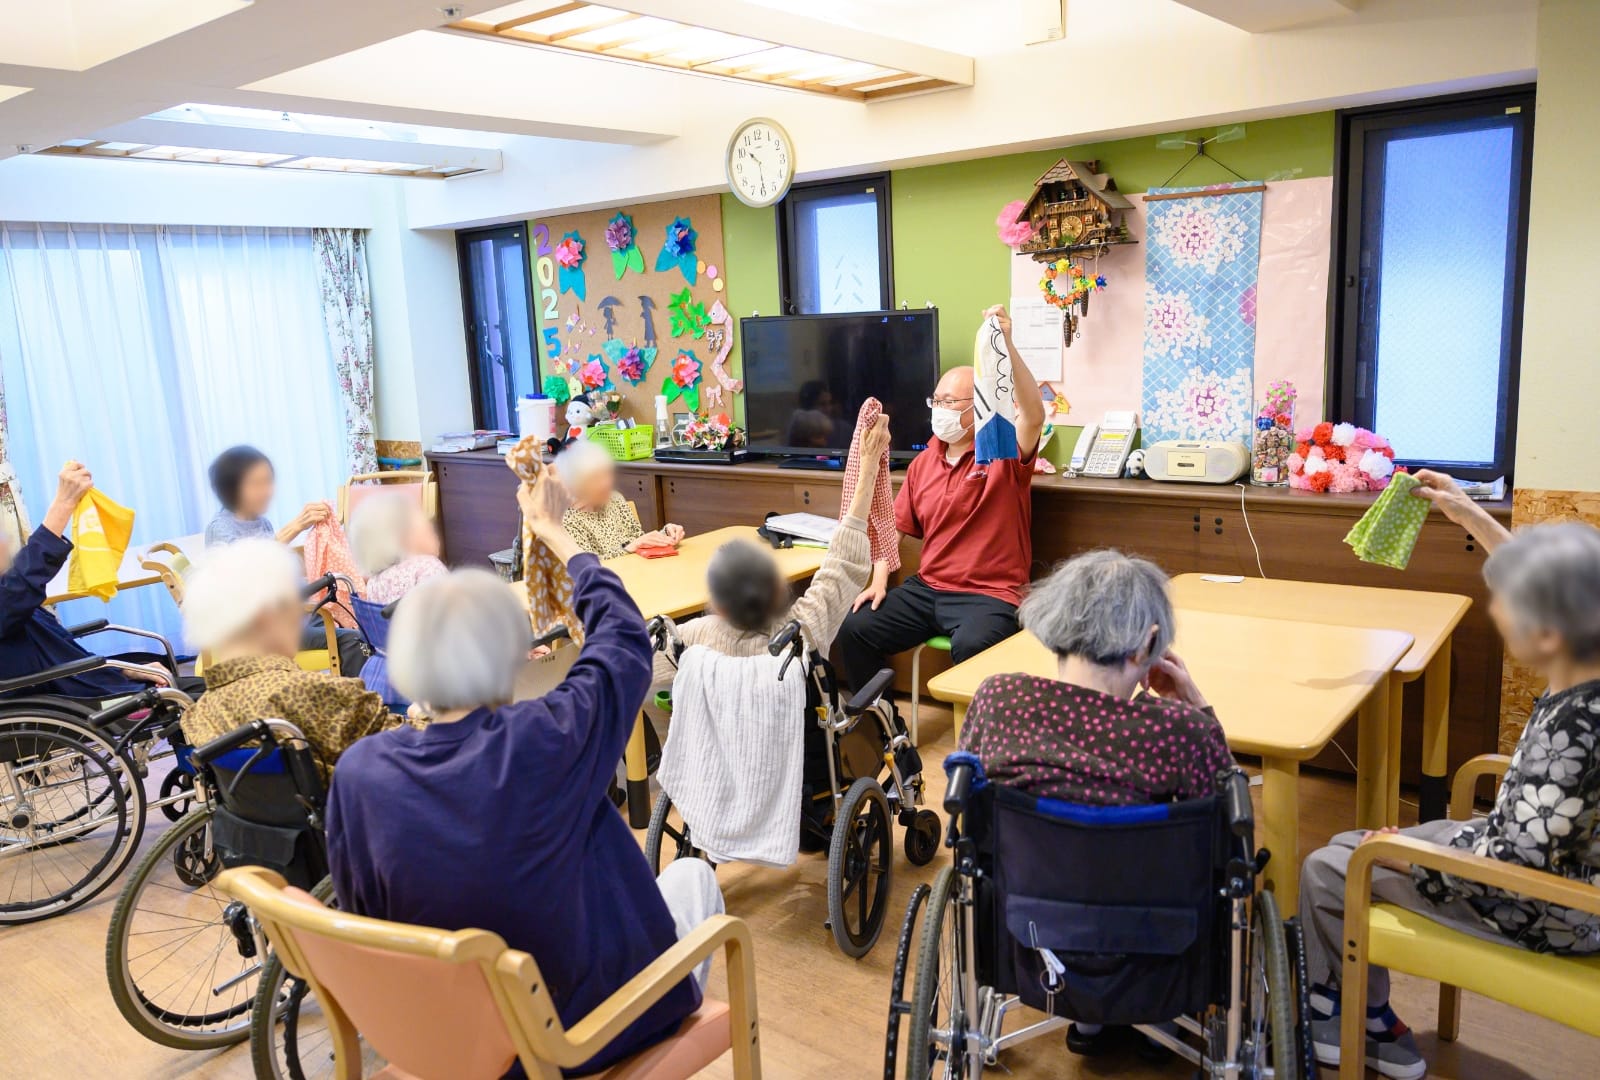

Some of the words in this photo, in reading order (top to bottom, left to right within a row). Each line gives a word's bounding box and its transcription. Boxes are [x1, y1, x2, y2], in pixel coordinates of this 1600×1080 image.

[744, 135, 751, 146] 11
[754, 129, 762, 141] 12
[774, 140, 780, 151] 2
[738, 148, 746, 158] 10
[779, 154, 786, 165] 3
[736, 163, 743, 174] 9
[742, 177, 748, 187] 8
[771, 182, 777, 192] 5
[750, 185, 756, 196] 7
[760, 187, 767, 197] 6
[533, 223, 562, 358] 2025
